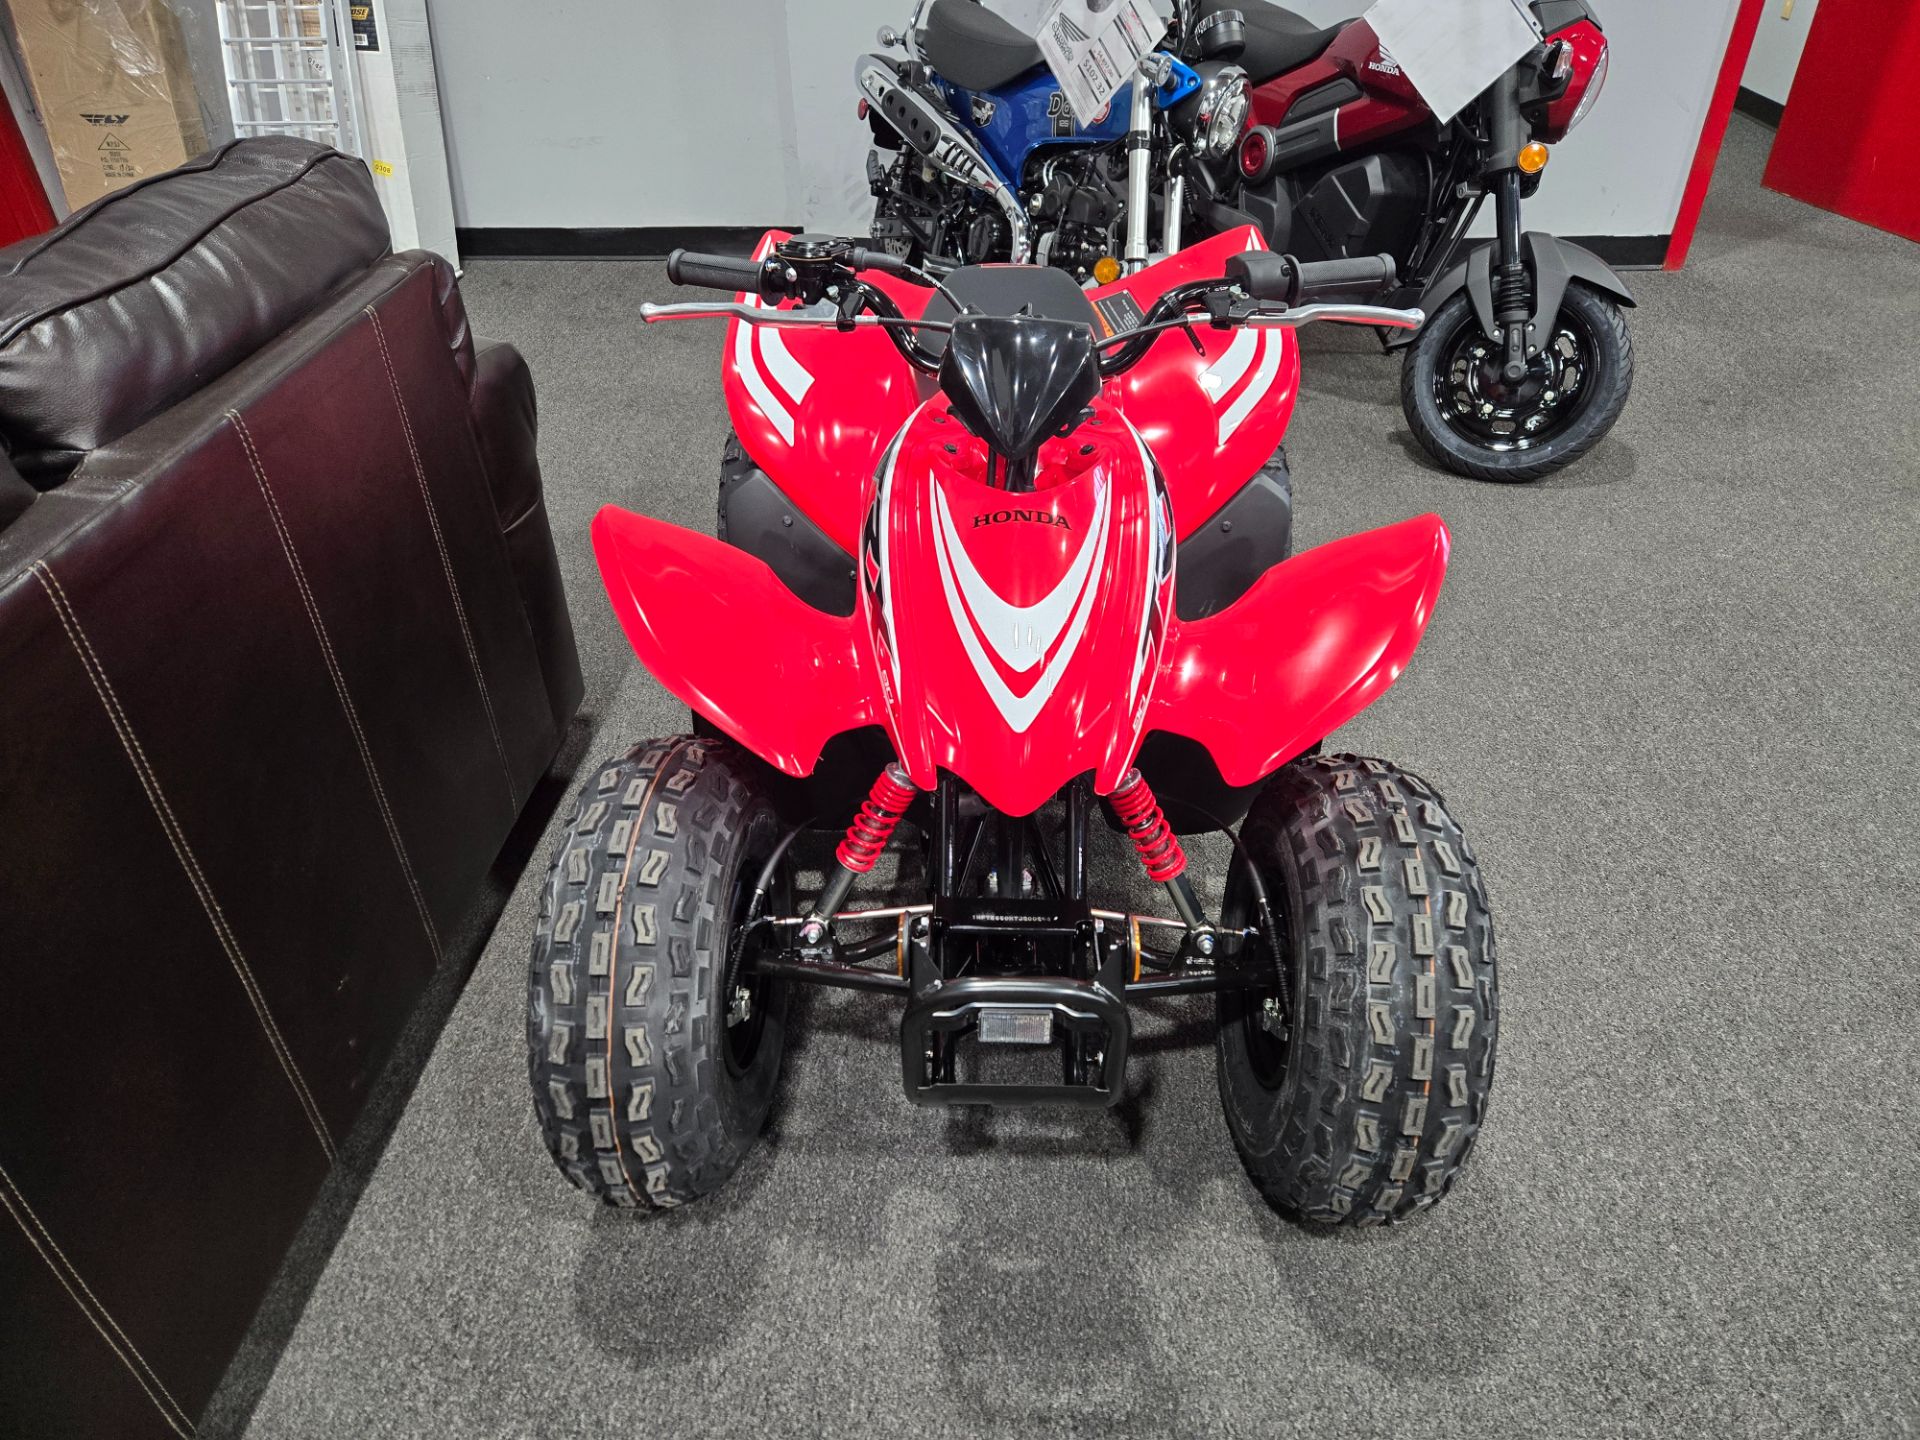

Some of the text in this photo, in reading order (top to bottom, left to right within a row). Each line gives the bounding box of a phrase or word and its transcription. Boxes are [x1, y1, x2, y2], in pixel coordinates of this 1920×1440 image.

[1368, 61, 1400, 76] HONDA
[79, 113, 130, 124] FLY
[973, 509, 1072, 531] HONDA
